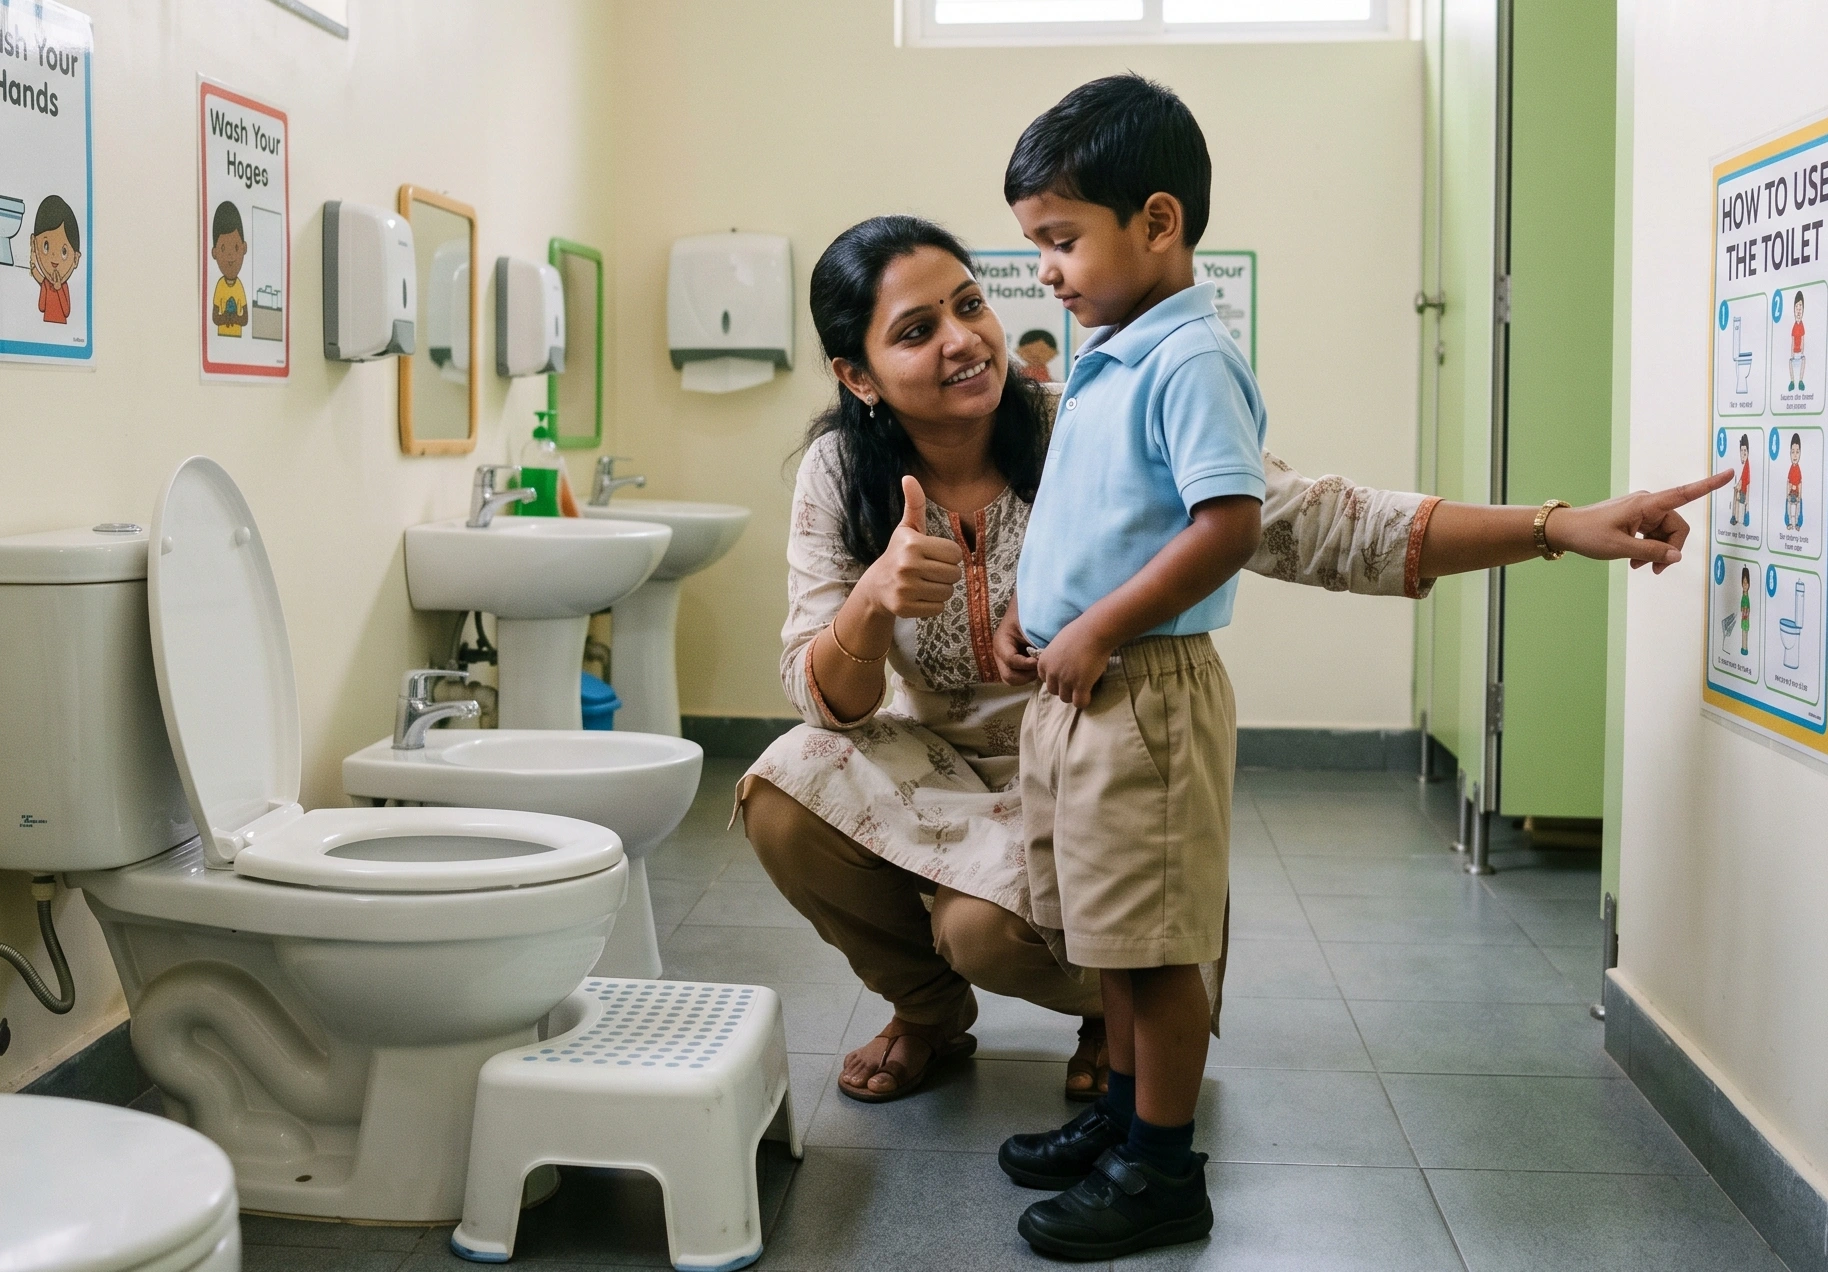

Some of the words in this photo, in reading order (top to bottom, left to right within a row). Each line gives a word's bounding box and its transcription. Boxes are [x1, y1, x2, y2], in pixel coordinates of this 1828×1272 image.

[34, 33, 78, 77] Your
[210, 108, 248, 146] Wash
[252, 123, 281, 156] Your
[227, 149, 269, 189] Hoges
[1722, 185, 1761, 234] HOW
[1765, 176, 1788, 219] TO
[1794, 160, 1828, 211] USE
[1203, 263, 1244, 278] Your
[1726, 238, 1757, 281] THE
[1762, 219, 1824, 272] TOILET
[988, 284, 1045, 298] Hands
